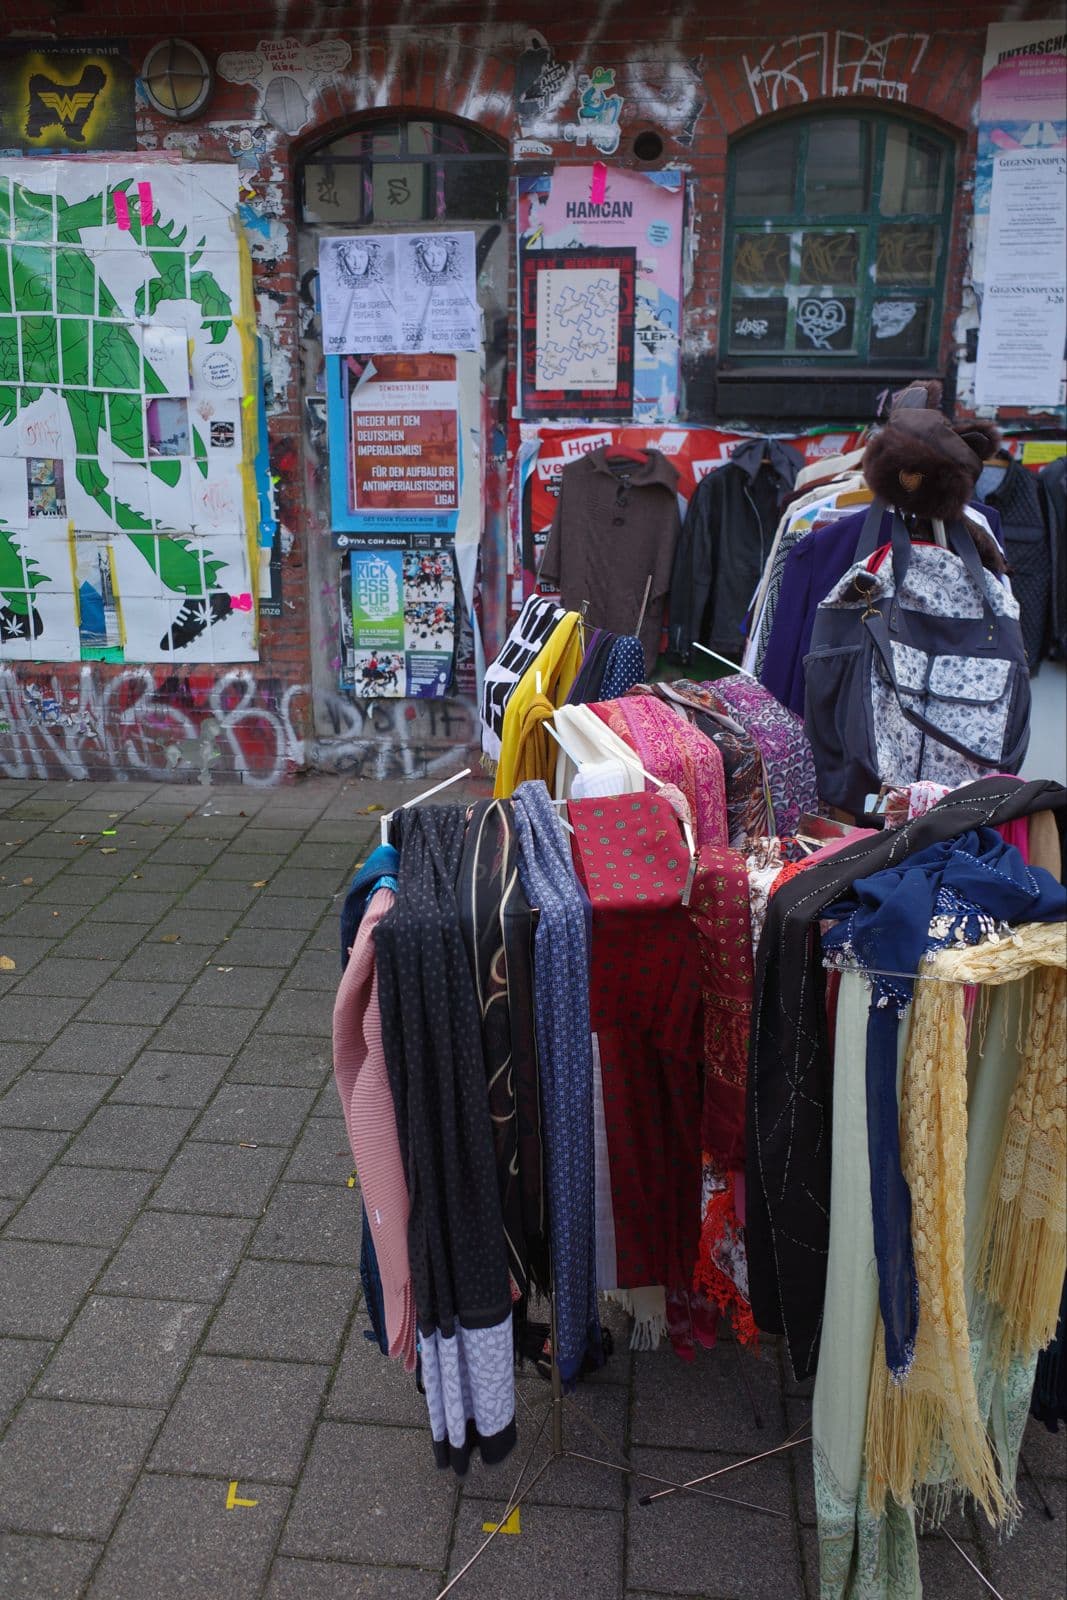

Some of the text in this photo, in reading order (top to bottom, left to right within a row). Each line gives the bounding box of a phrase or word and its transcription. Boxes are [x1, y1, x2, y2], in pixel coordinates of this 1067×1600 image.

[566, 201, 633, 218] HAMCAN
[379, 384, 430, 392] DEMONSTRATION
[357, 415, 421, 427] NIEDER MIT DEM
[357, 430, 405, 441] DEUTSCHEN
[358, 444, 422, 456] IMPERIALISMUS!
[568, 437, 608, 456] Hart
[371, 465, 455, 477] FÜR DEN AUFBAU DER
[363, 480, 455, 491] ANTIIMPERIALISTISCHEN
[435, 494, 455, 505] LIGA!
[357, 564, 388, 579] KICK
[358, 579, 389, 593] ASS
[359, 593, 389, 607] CUP
